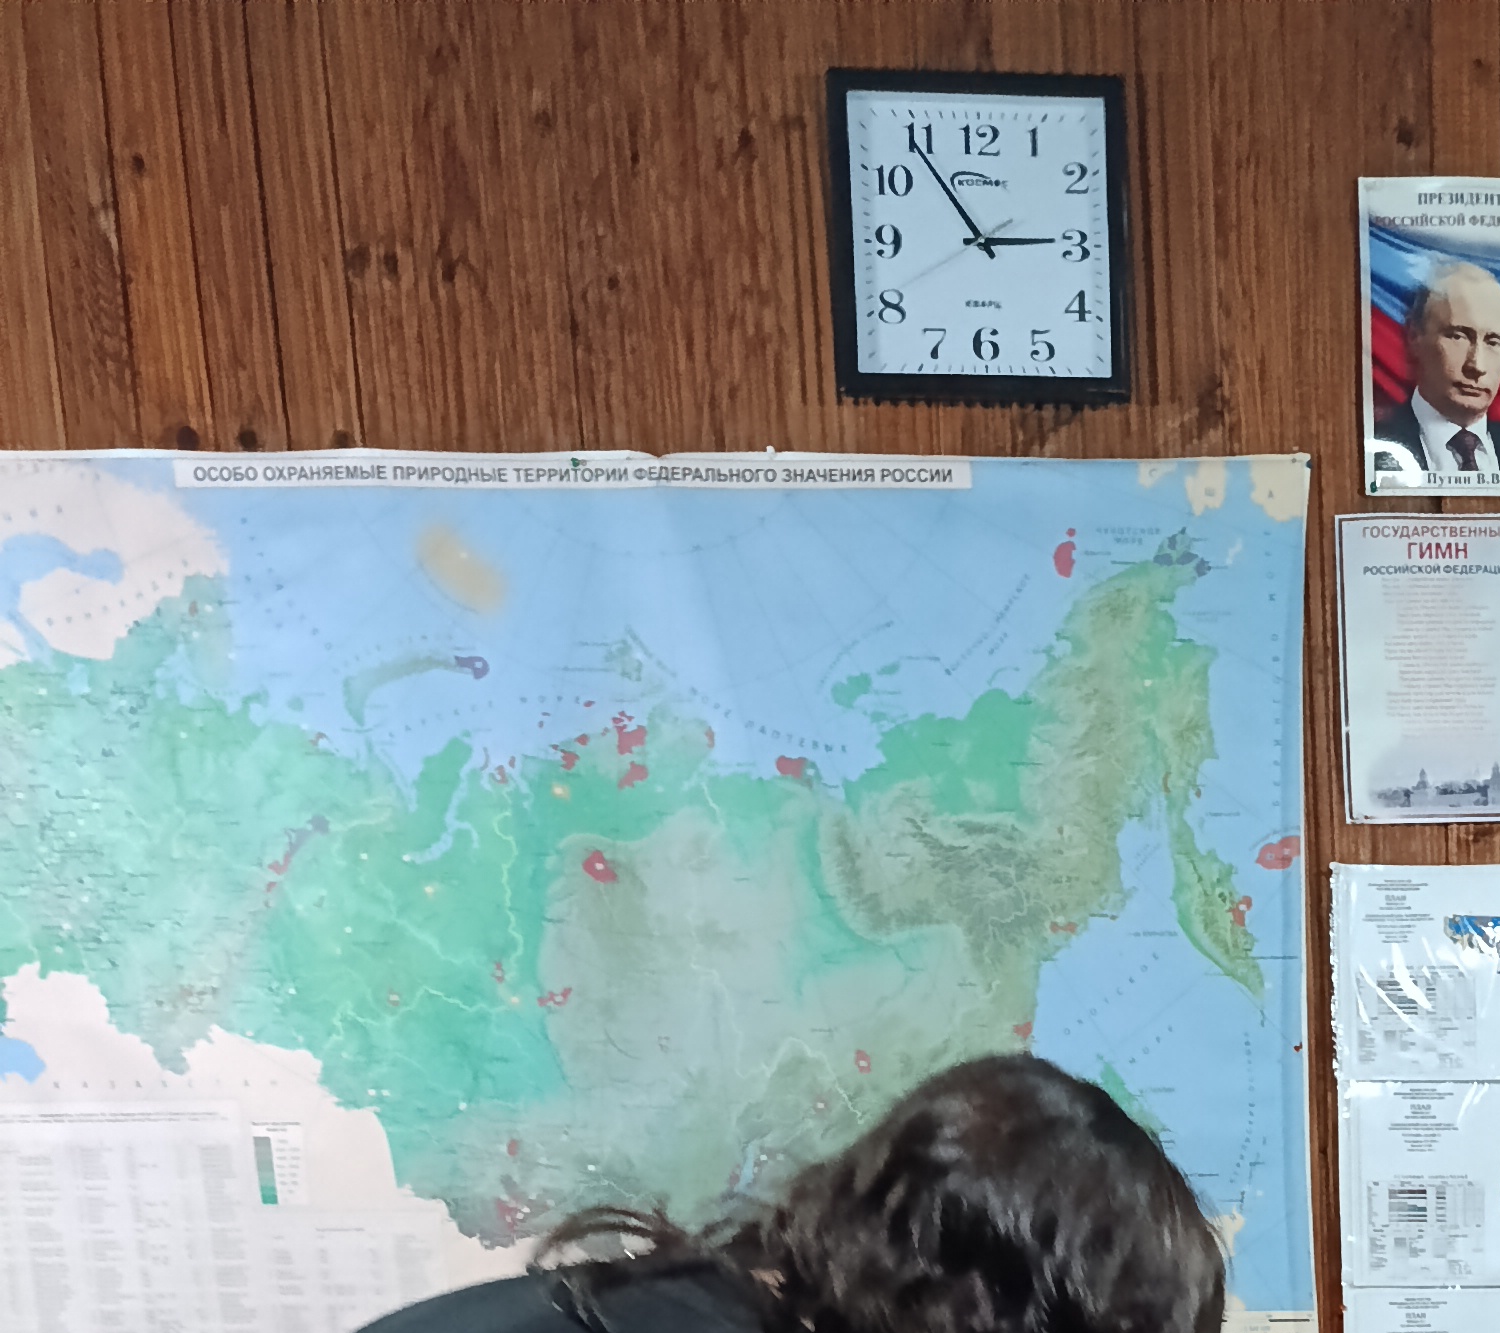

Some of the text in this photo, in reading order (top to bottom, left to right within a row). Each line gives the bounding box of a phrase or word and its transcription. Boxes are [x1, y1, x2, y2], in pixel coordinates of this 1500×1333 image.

[904, 122, 935, 156] 11
[959, 124, 1001, 158] 12
[1027, 126, 1039, 158] 1
[873, 163, 914, 197] 10
[1062, 162, 1091, 196] 2
[1375, 212, 1466, 228] РОССИЙСКОЙ
[874, 223, 903, 260] 9
[1061, 228, 1092, 263] 3
[877, 287, 908, 325] 8
[1063, 289, 1093, 324] 4
[922, 327, 948, 361] 7
[971, 326, 1001, 362] 6
[1029, 329, 1056, 363] 5
[193, 463, 954, 484] ОСОБО ОХРАНЯЕМЫЕ ПРИРОДНЫЕ ТЕРРИТОРИИ ФЕДЕРАЛЬНОГО ЗНАЧЕНИЯ РОССИИ
[1427, 472, 1471, 486] Путин
[1407, 541, 1469, 560] ГИМН
[1362, 563, 1441, 576] РОССИЙСКОЙ
